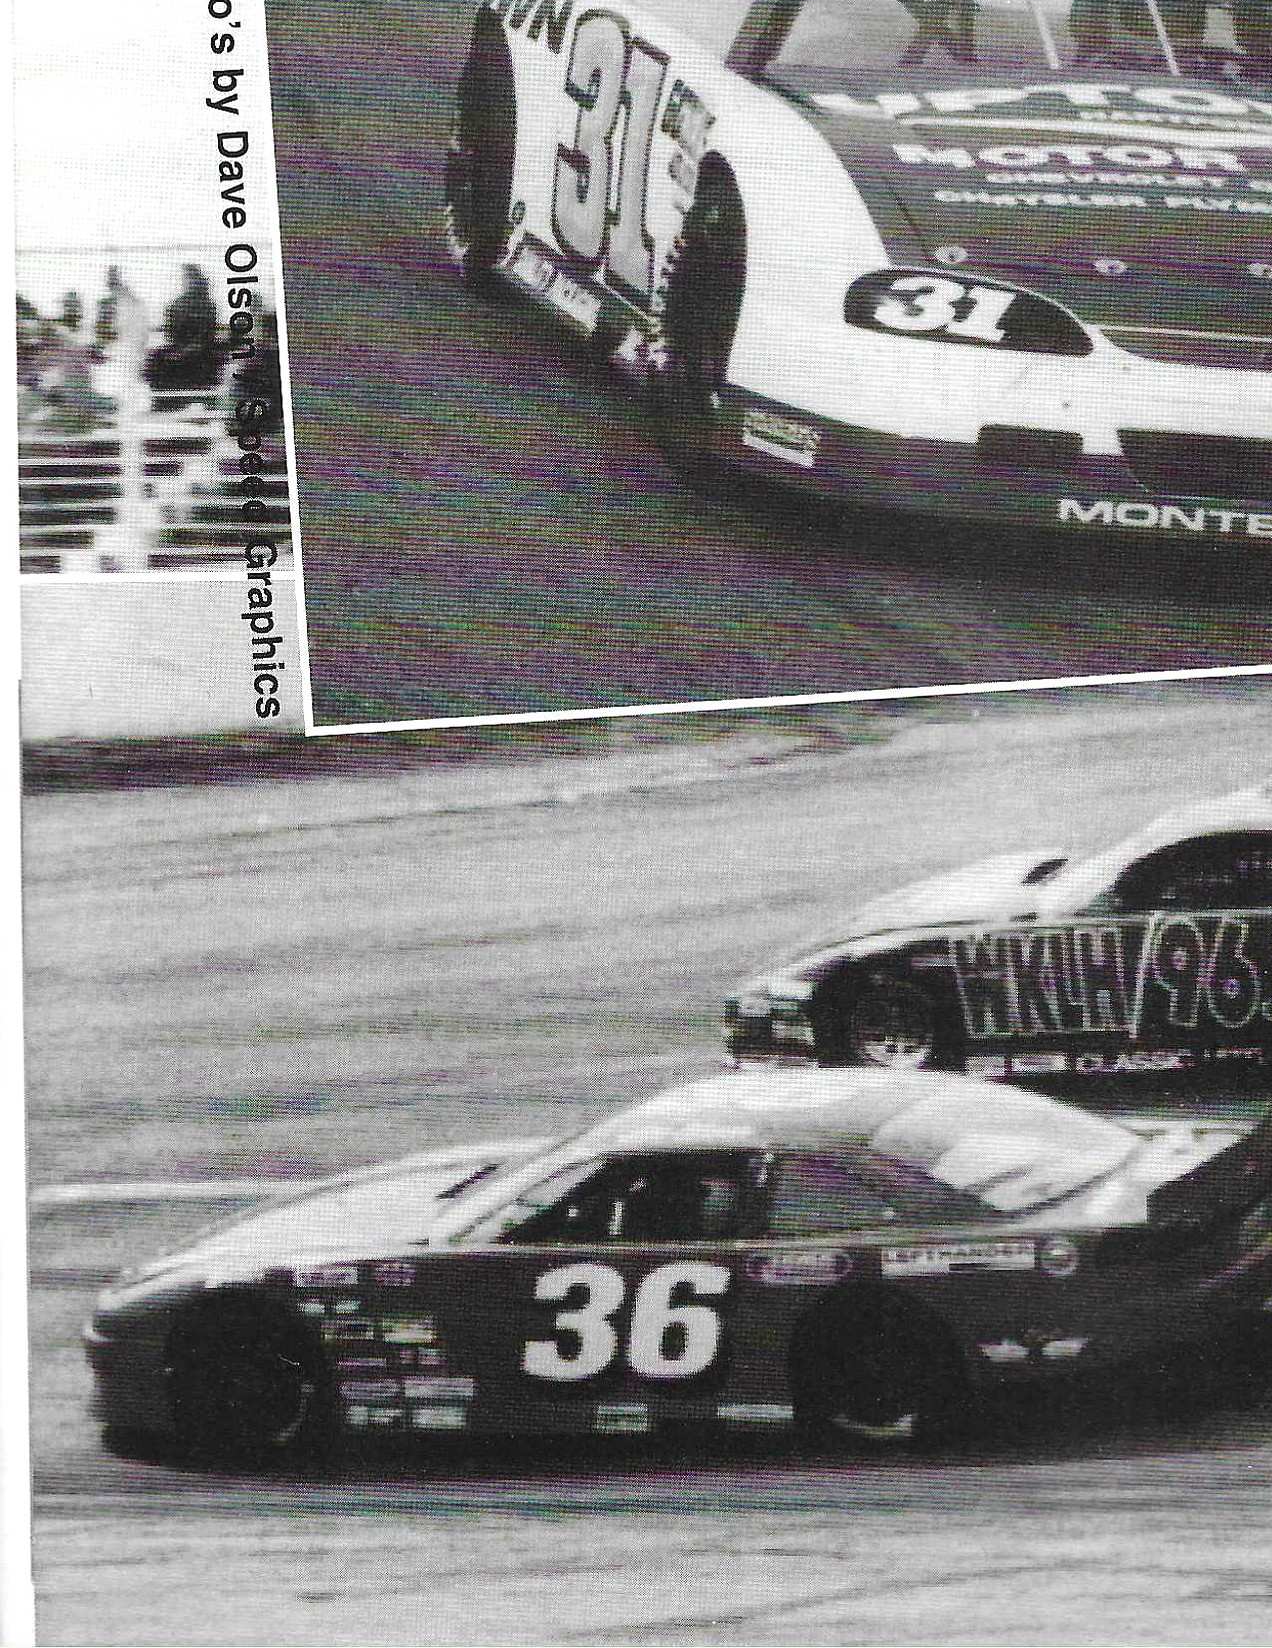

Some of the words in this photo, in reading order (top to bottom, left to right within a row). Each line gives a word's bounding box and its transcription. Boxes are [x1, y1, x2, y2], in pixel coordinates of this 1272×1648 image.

[550, 8, 671, 315] 31
[892, 143, 1250, 172] MOTOR
[875, 276, 1017, 344] 31
[522, 1262, 732, 1383] 36
